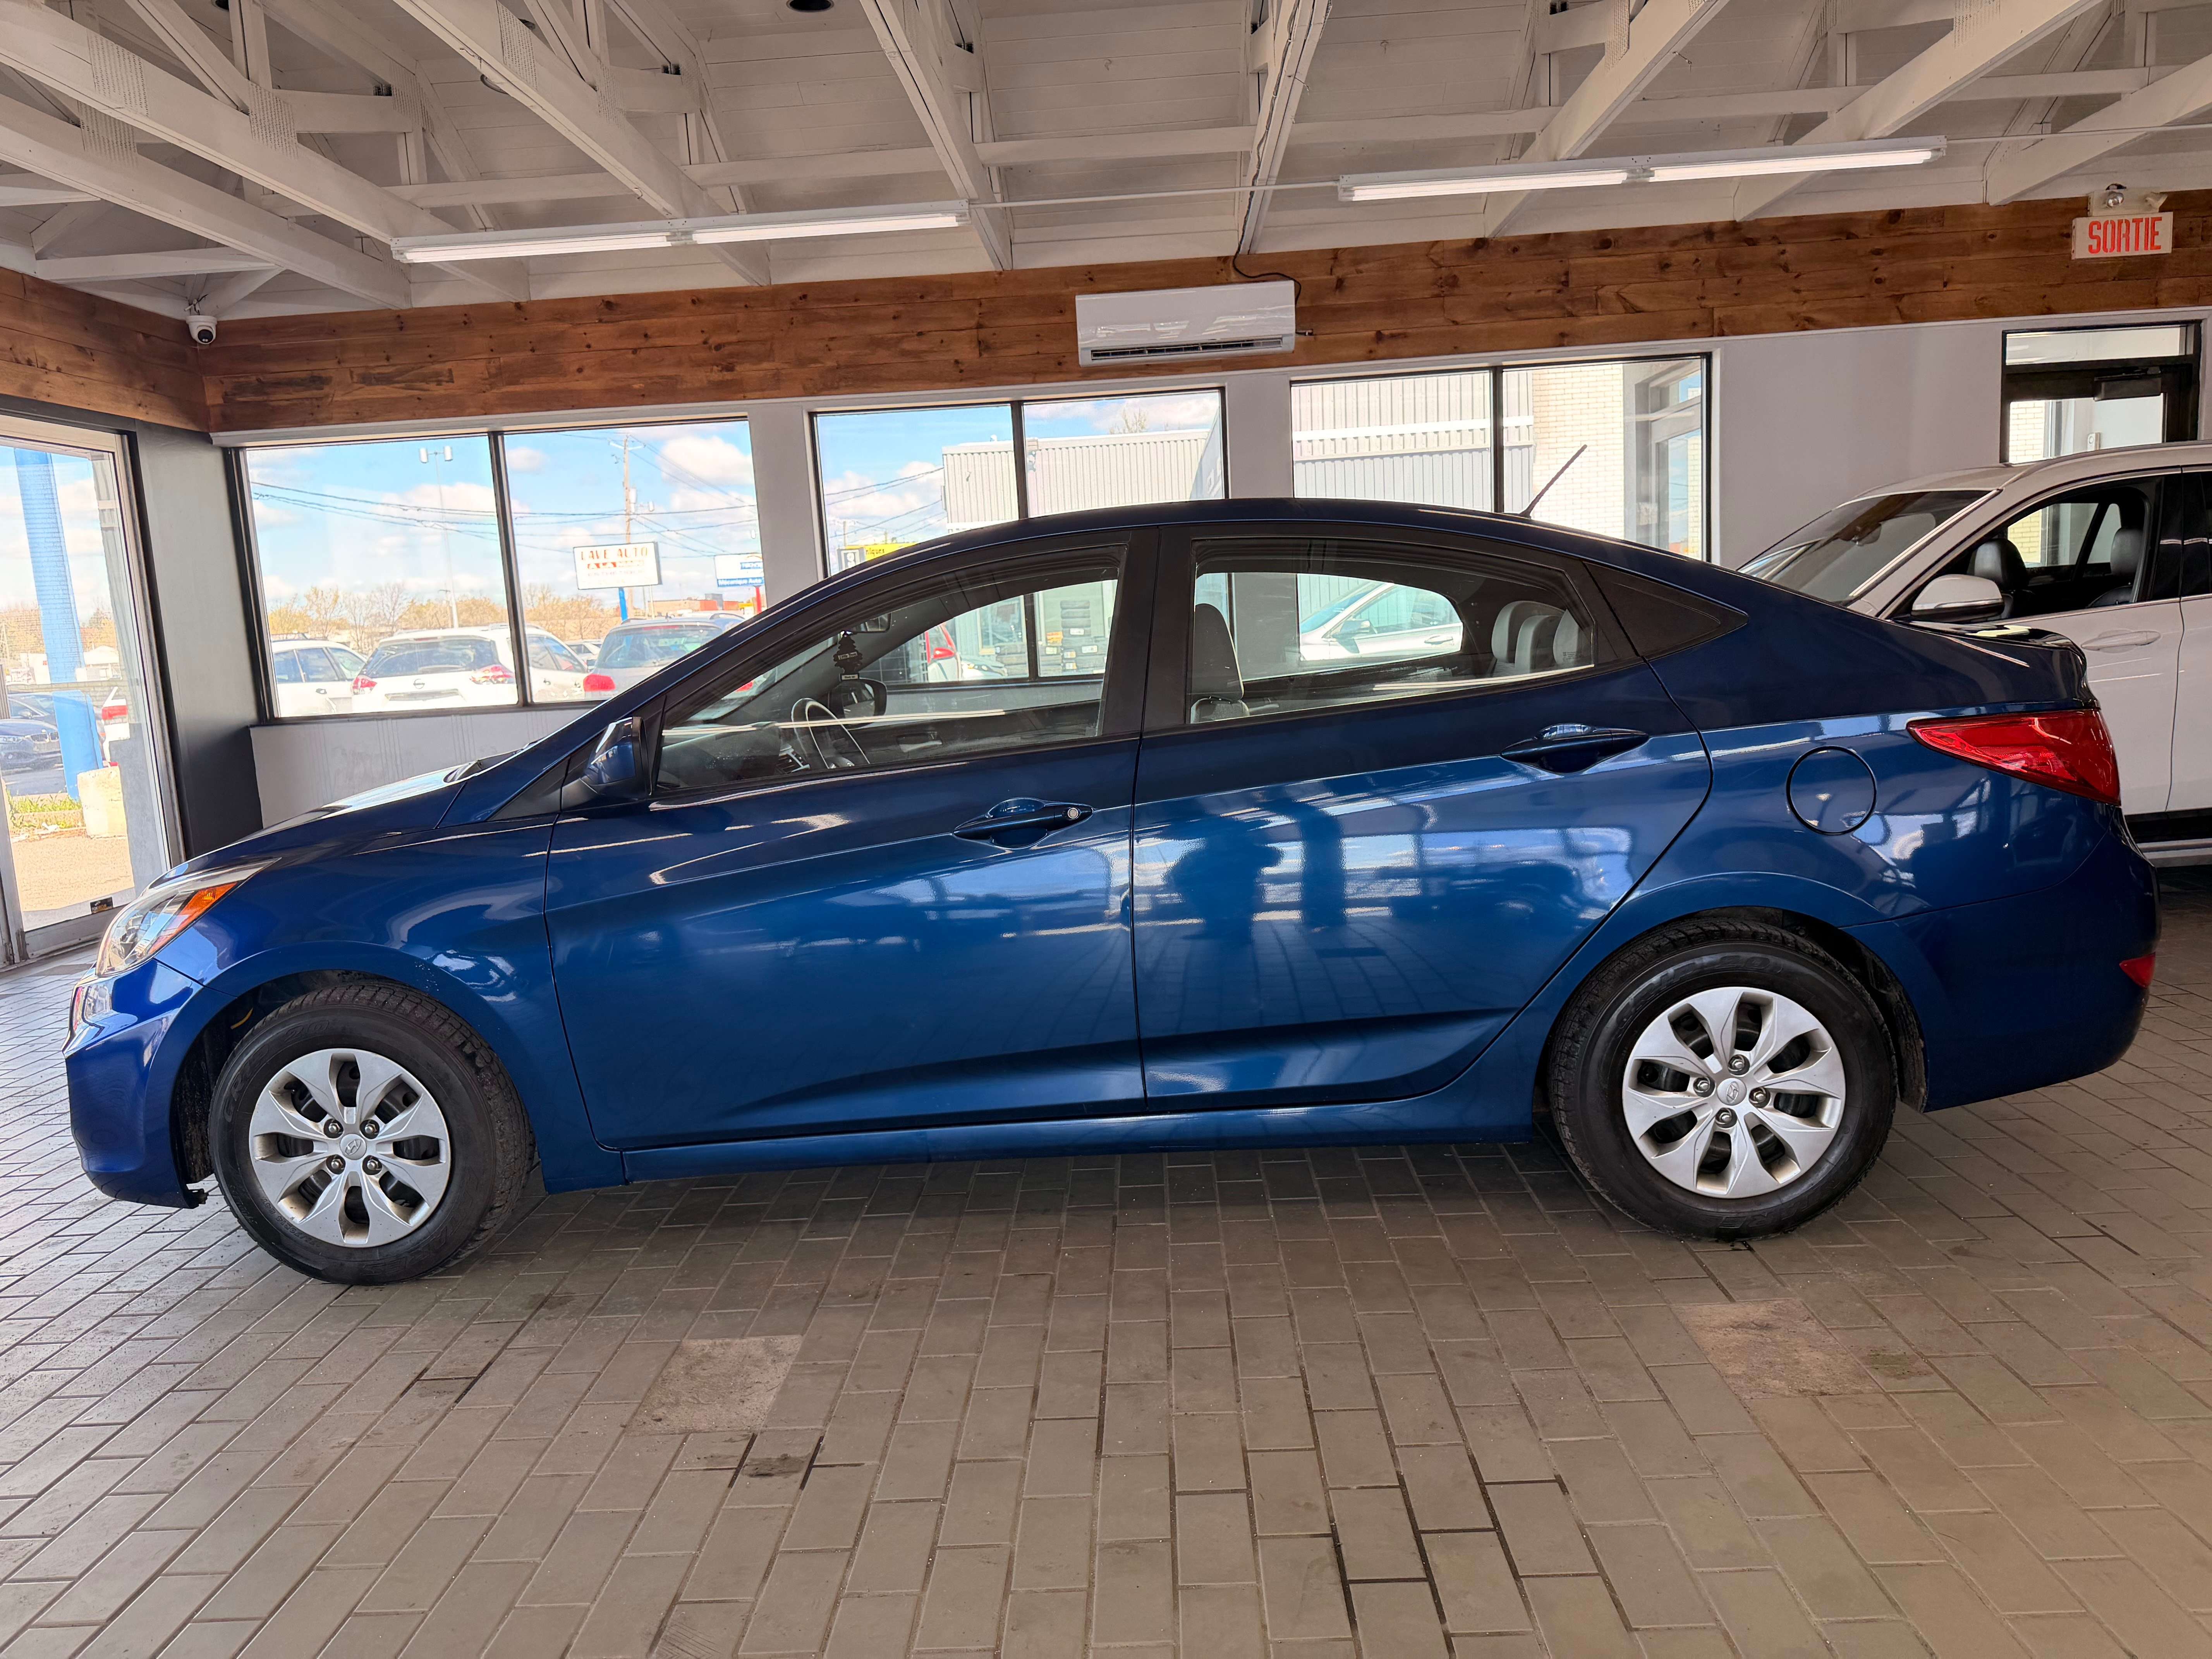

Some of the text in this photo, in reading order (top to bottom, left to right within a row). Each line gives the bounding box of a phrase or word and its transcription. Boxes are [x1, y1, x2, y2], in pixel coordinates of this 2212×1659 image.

[2088, 216, 2162, 254] SORTIE
[580, 546, 648, 561] LAVE AUTO
